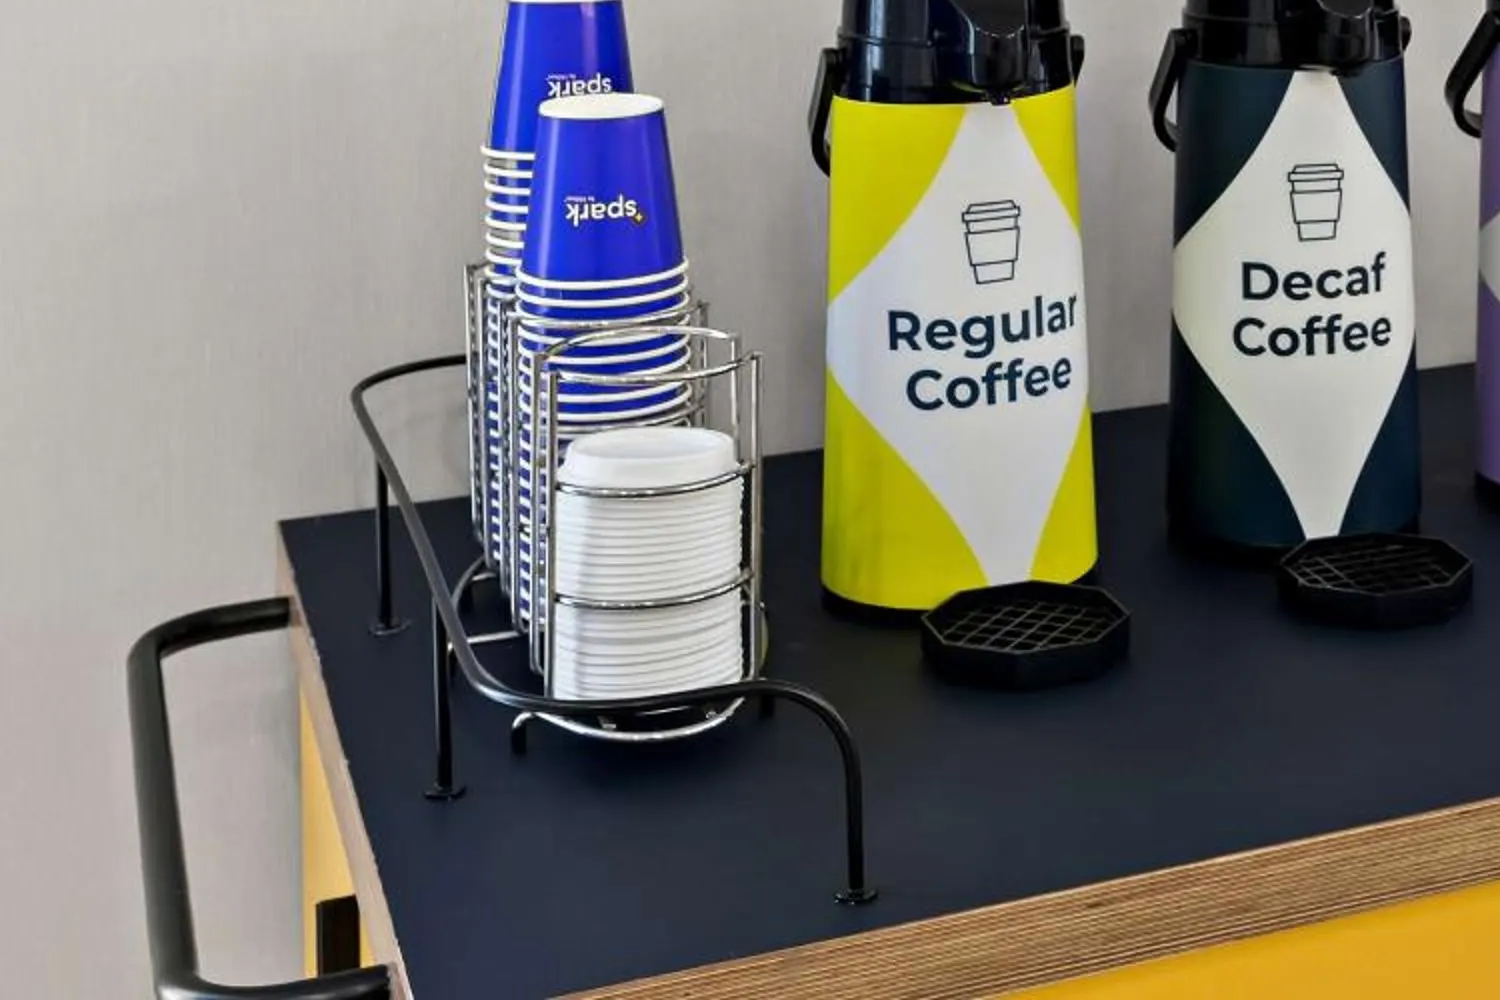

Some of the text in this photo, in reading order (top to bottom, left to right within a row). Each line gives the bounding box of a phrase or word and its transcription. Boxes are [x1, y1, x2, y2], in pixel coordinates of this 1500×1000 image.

[547, 72, 612, 98] spark
[565, 193, 637, 228] spark
[1241, 251, 1386, 301] Decaf
[888, 294, 1077, 359] Regular
[1232, 313, 1392, 357] Coffee
[906, 357, 1072, 411] Coffee
